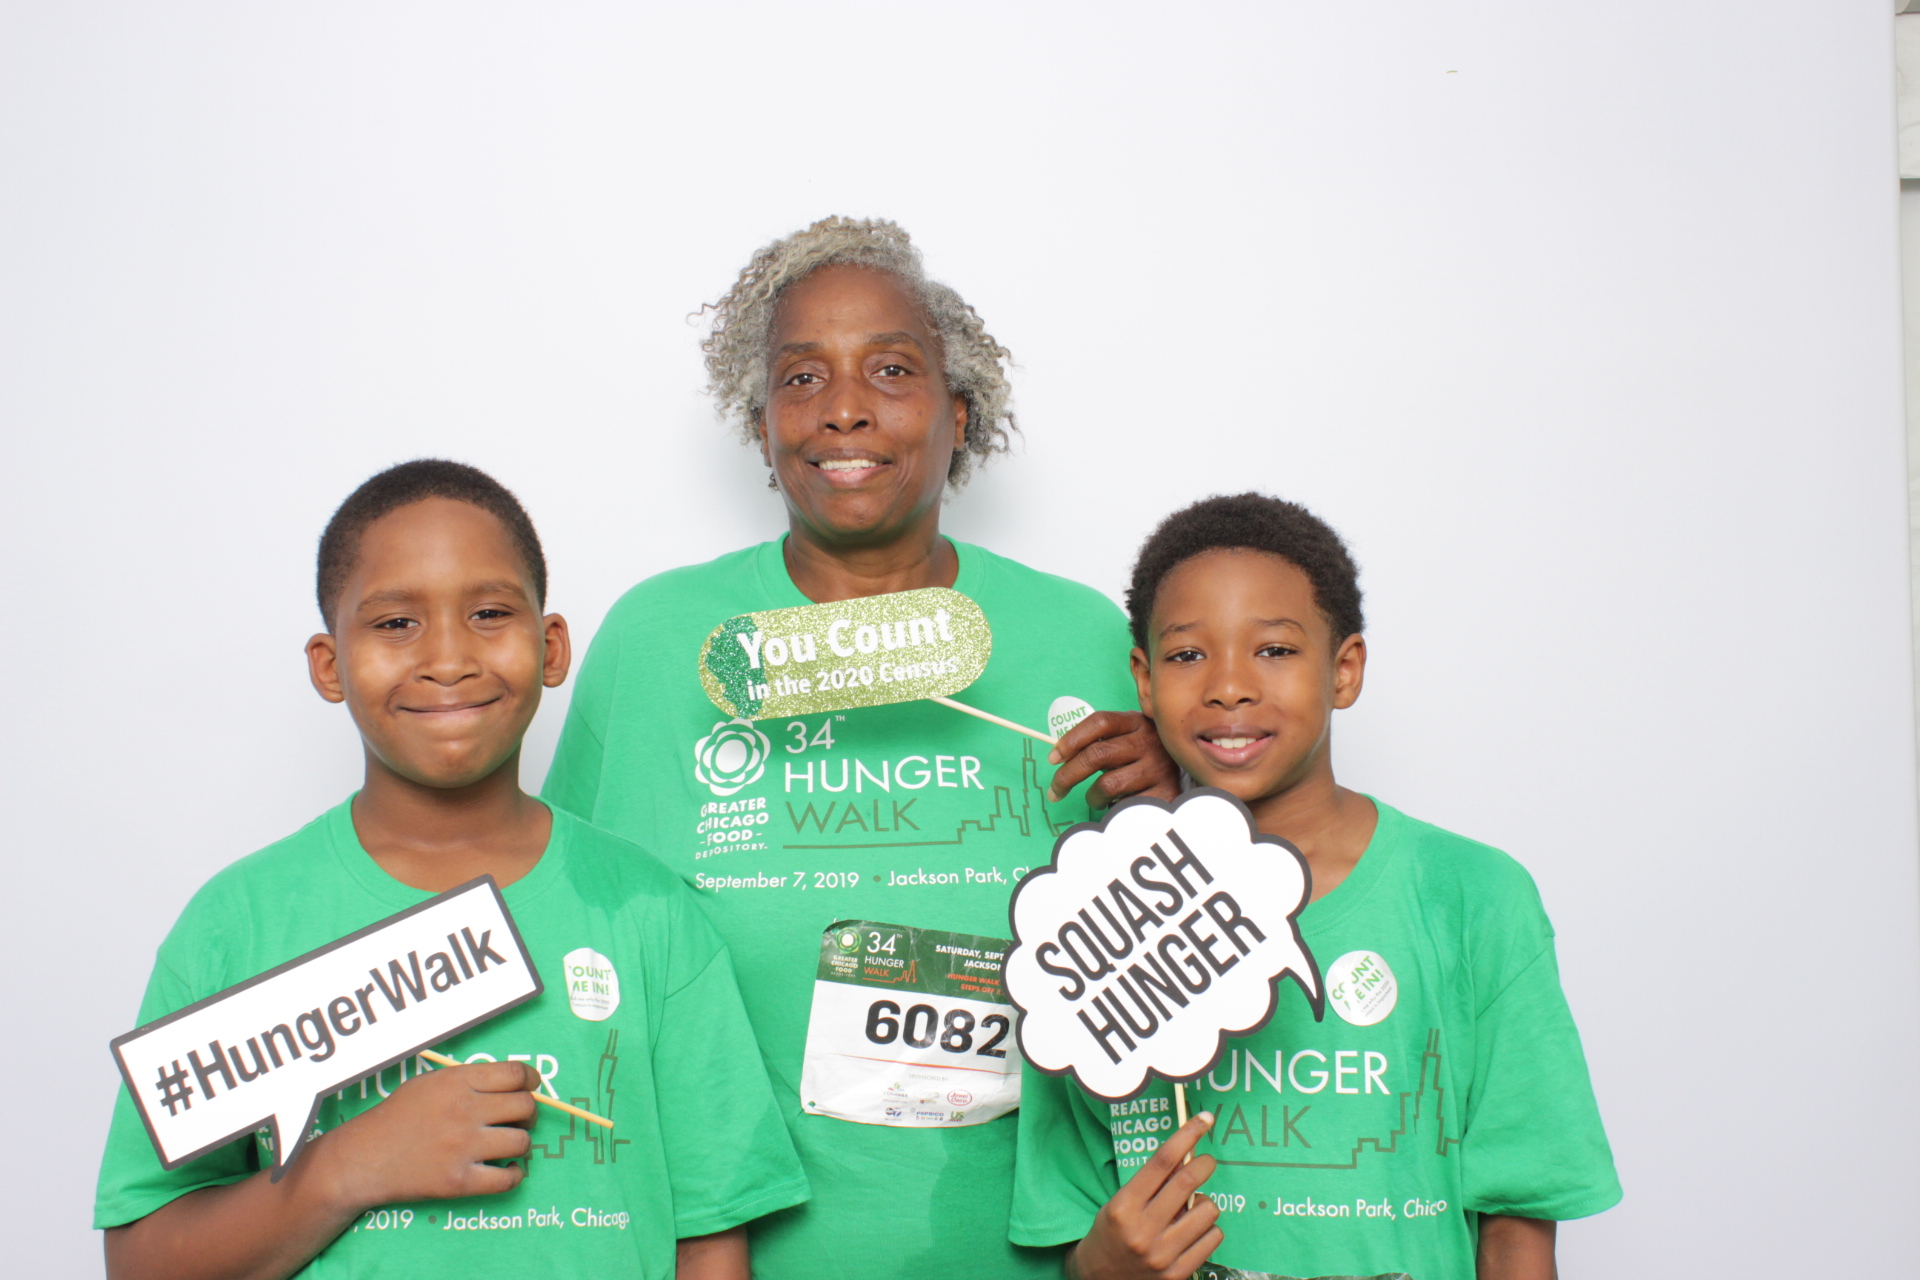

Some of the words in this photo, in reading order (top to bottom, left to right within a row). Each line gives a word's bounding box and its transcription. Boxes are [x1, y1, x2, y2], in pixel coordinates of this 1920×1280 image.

[736, 630, 818, 670] You
[828, 608, 954, 658] Count
[747, 680, 770, 701] in
[776, 674, 811, 697] the
[816, 665, 873, 692] 2020
[879, 657, 957, 684] Census
[1050, 706, 1087, 727] COUNT
[785, 755, 985, 793] HUNGER
[700, 797, 767, 818] GREATER
[785, 798, 921, 834] WALK
[696, 812, 769, 834] CHICAGO
[695, 871, 788, 893] September
[792, 871, 807, 891] 7,
[813, 871, 860, 889] 2019
[887, 867, 960, 887] Jackson
[964, 866, 1007, 886] Park,
[1035, 828, 1214, 1001] SQUASH
[832, 955, 858, 963] GREATER
[864, 955, 905, 968] HUNGER
[935, 945, 982, 959] SATURDAY,
[568, 965, 612, 981] OUNT
[831, 960, 858, 969] CHICAGO
[863, 966, 890, 977] WALK
[592, 981, 610, 996] IN!
[947, 973, 977, 982] HUNGER
[979, 977, 1000, 985] WALK
[960, 984, 980, 992] STEPS
[1076, 890, 1267, 1065] HUNGER
[1361, 969, 1384, 991] IN!
[155, 926, 508, 1118] #HungerWalk
[865, 1000, 1010, 1059] 6082
[1184, 1048, 1391, 1095] UNGER
[364, 1209, 414, 1230] 2019
[443, 1209, 523, 1230] Jackson
[527, 1206, 565, 1229] Park,
[1273, 1197, 1350, 1217] Jackson
[1356, 1198, 1397, 1221] Park,
